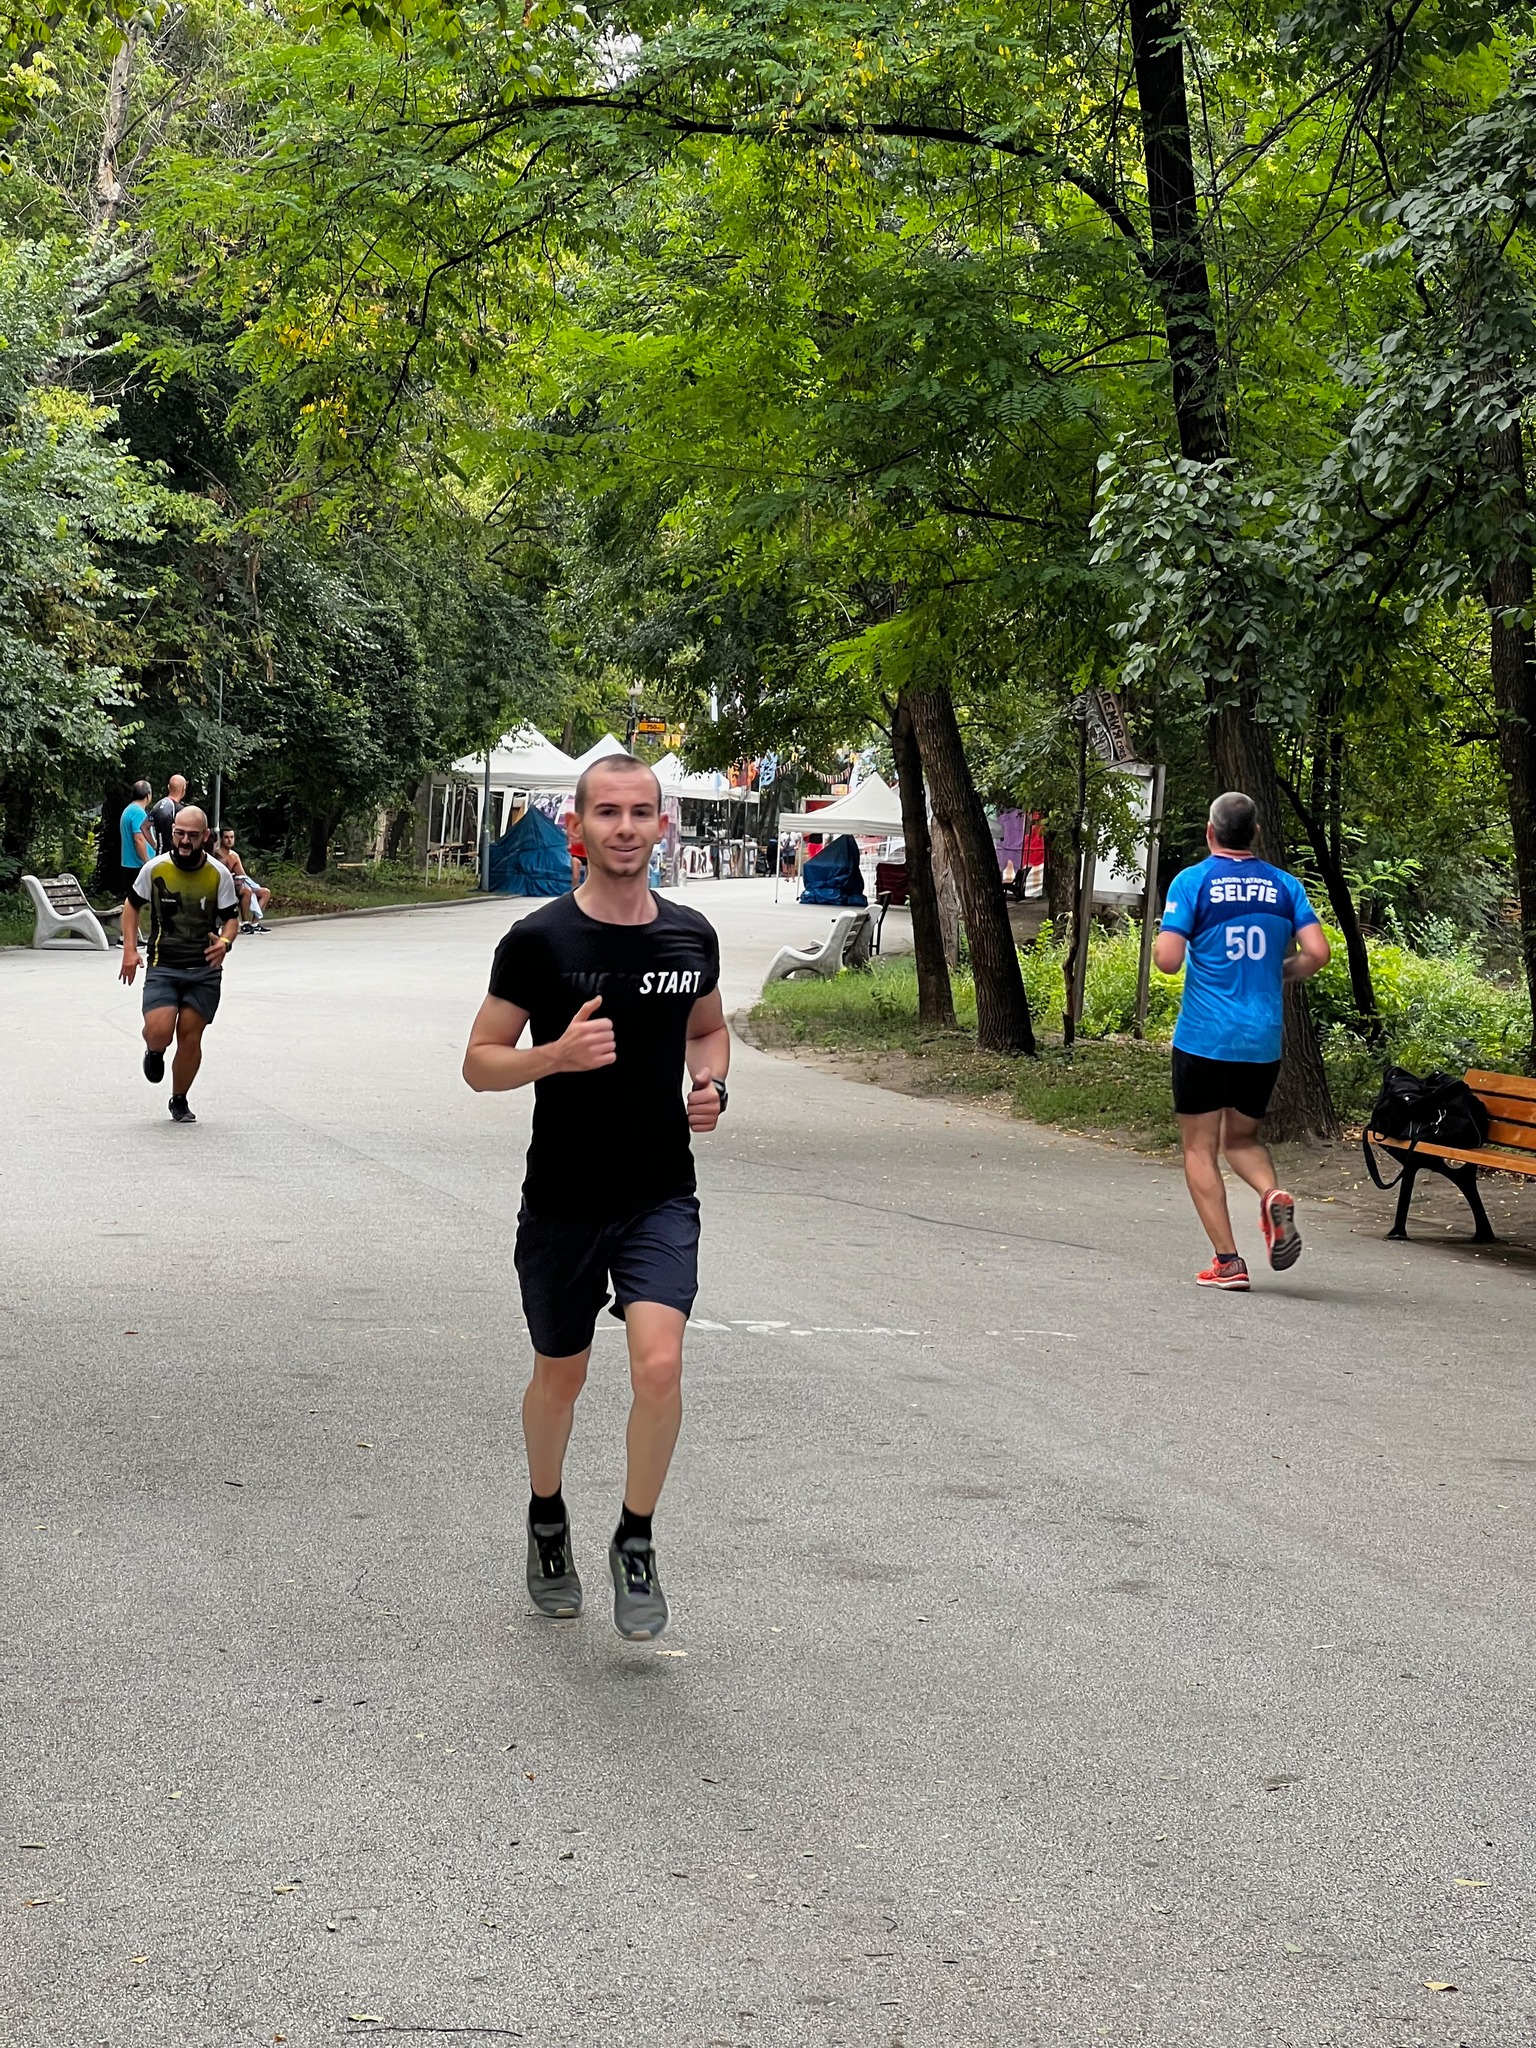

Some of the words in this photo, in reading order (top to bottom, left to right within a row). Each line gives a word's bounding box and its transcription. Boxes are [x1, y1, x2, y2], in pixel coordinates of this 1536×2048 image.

[1209, 884, 1278, 904] SELFIE
[1225, 925, 1267, 961] 50
[639, 970, 701, 995] START
